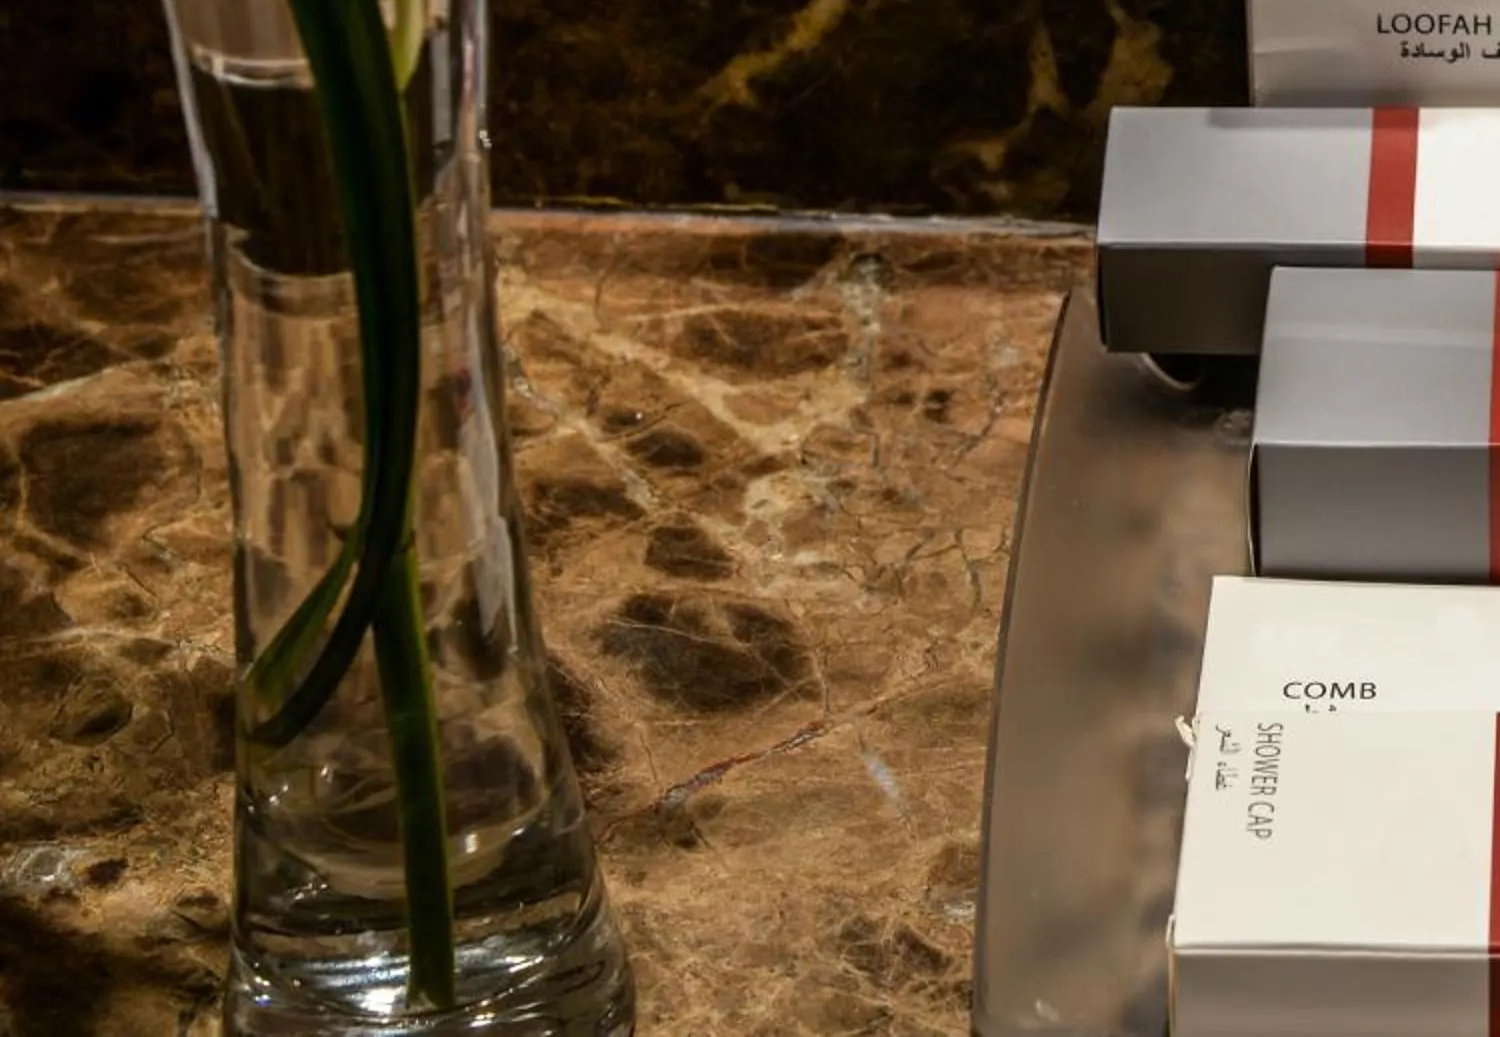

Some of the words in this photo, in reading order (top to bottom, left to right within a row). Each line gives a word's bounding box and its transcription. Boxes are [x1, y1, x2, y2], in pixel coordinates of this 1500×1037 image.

[1377, 13, 1492, 36] LOOFAH
[1400, 41, 1471, 63] الوسادة
[1283, 681, 1377, 700] COMB
[1249, 723, 1284, 796] SHOWER
[1247, 801, 1275, 840] CAP
